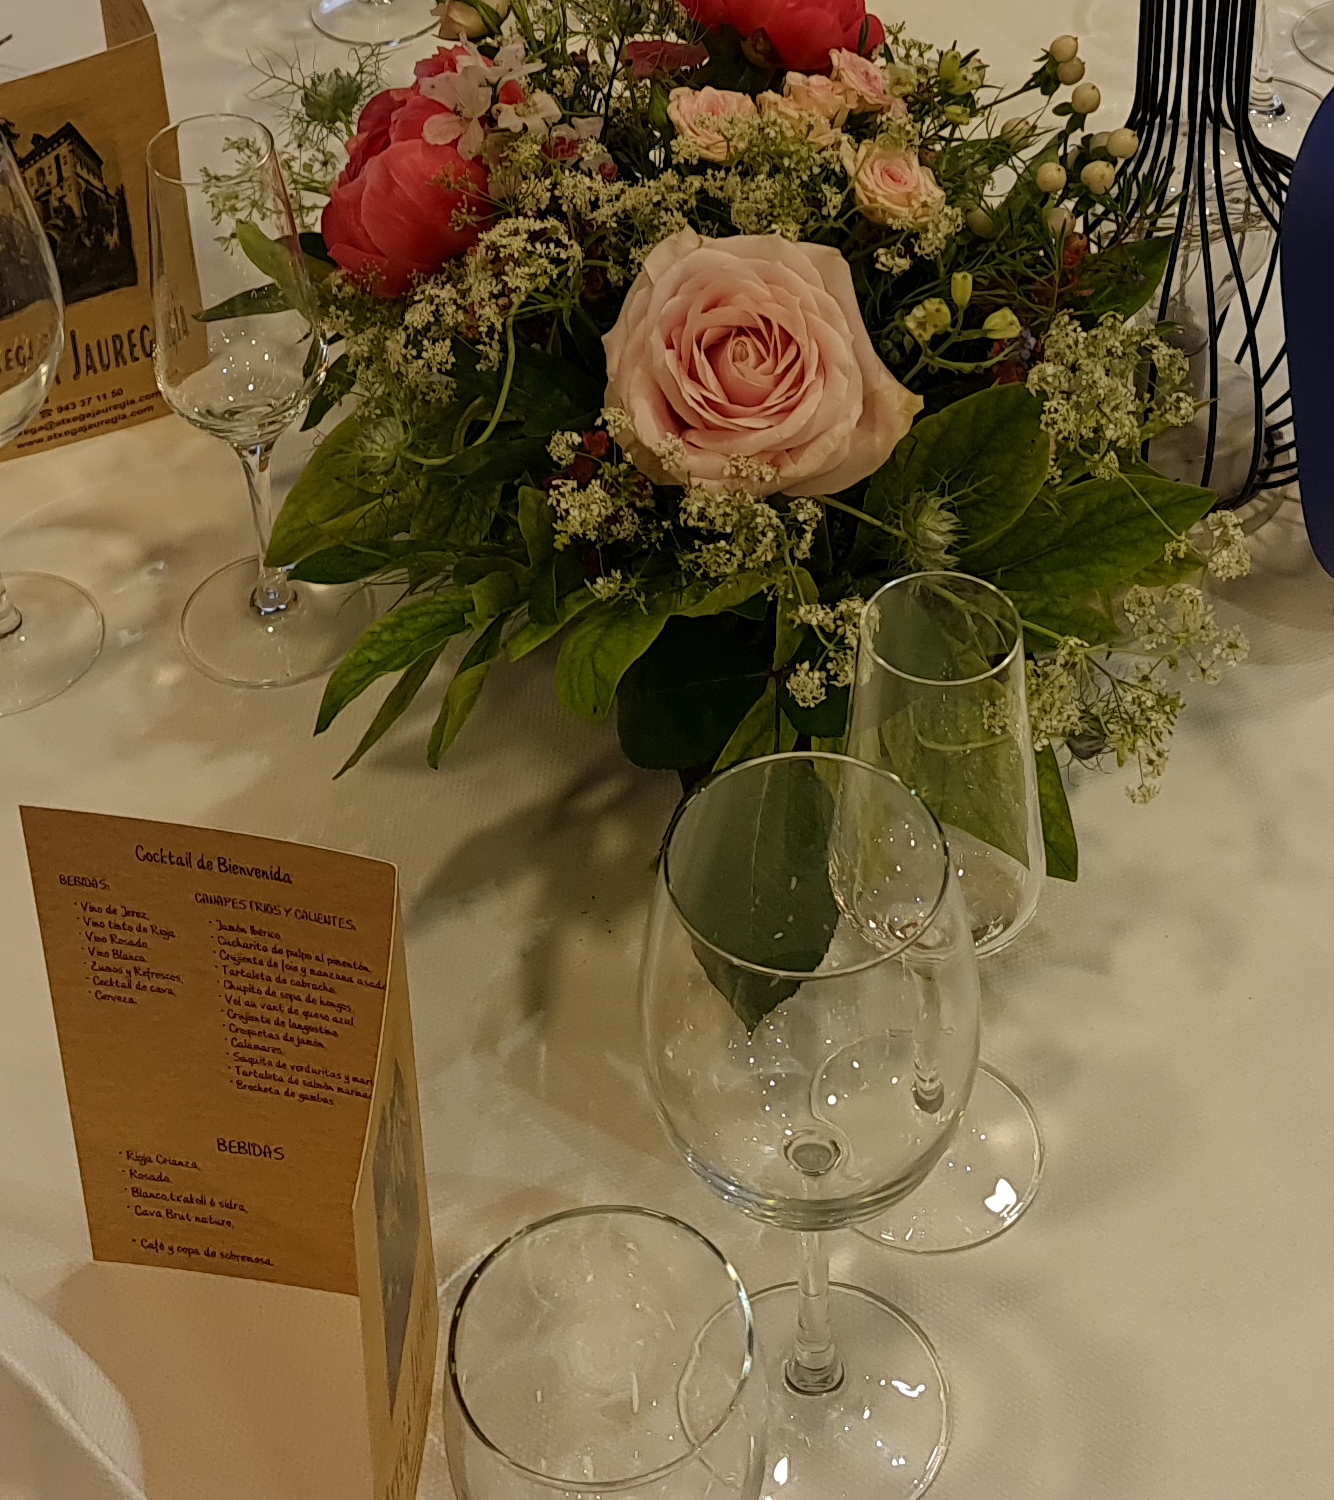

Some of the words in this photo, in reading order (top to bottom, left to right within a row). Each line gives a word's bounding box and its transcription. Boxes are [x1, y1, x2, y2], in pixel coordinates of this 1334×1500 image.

[97, 392, 109, 404] 11
[135, 844, 192, 869] Cocktail
[197, 854, 213, 871] de
[217, 856, 293, 884] Bienvenida
[81, 902, 103, 914] Vino
[106, 904, 118, 915] de
[283, 907, 293, 917] Y
[83, 916, 105, 929] Vino
[109, 919, 133, 933] tinto
[136, 923, 148, 934] de
[85, 931, 108, 943] Vino
[87, 946, 110, 958] Vino
[271, 943, 284, 955] de
[286, 948, 313, 962] pulpo
[315, 952, 325, 963] al
[126, 968, 132, 978] y
[222, 964, 272, 982] Tartaleta
[275, 972, 287, 984] de
[267, 957, 279, 969] de
[301, 966, 307, 976] y
[309, 968, 355, 984] manzana
[93, 975, 132, 990] Cocktail
[136, 981, 148, 992] de
[223, 979, 263, 996] Chupito
[265, 986, 277, 998] de
[279, 991, 303, 1004] sopa
[305, 993, 317, 1005] de
[224, 994, 242, 1006] Vol
[244, 1000, 258, 1009] au
[287, 1004, 299, 1016] de
[302, 1009, 330, 1023] queso
[274, 1015, 286, 1027] de
[229, 1022, 280, 1040] Croquetas
[282, 1030, 295, 1042] de
[233, 1051, 273, 1067] Saquito
[275, 1058, 287, 1069] de
[289, 1062, 342, 1080] verduritas
[344, 1074, 350, 1084] y
[235, 1065, 284, 1083] Tartaleta
[287, 1074, 299, 1085] de
[236, 1079, 280, 1096] Brocheta
[284, 1087, 296, 1098] de
[126, 1149, 154, 1167] Rioja
[216, 1137, 285, 1161] BEBIDAS
[135, 1204, 163, 1219] Cava
[166, 1208, 192, 1223] Brut
[168, 1245, 175, 1256] y
[177, 1245, 201, 1258] copa
[204, 1247, 217, 1259] de
